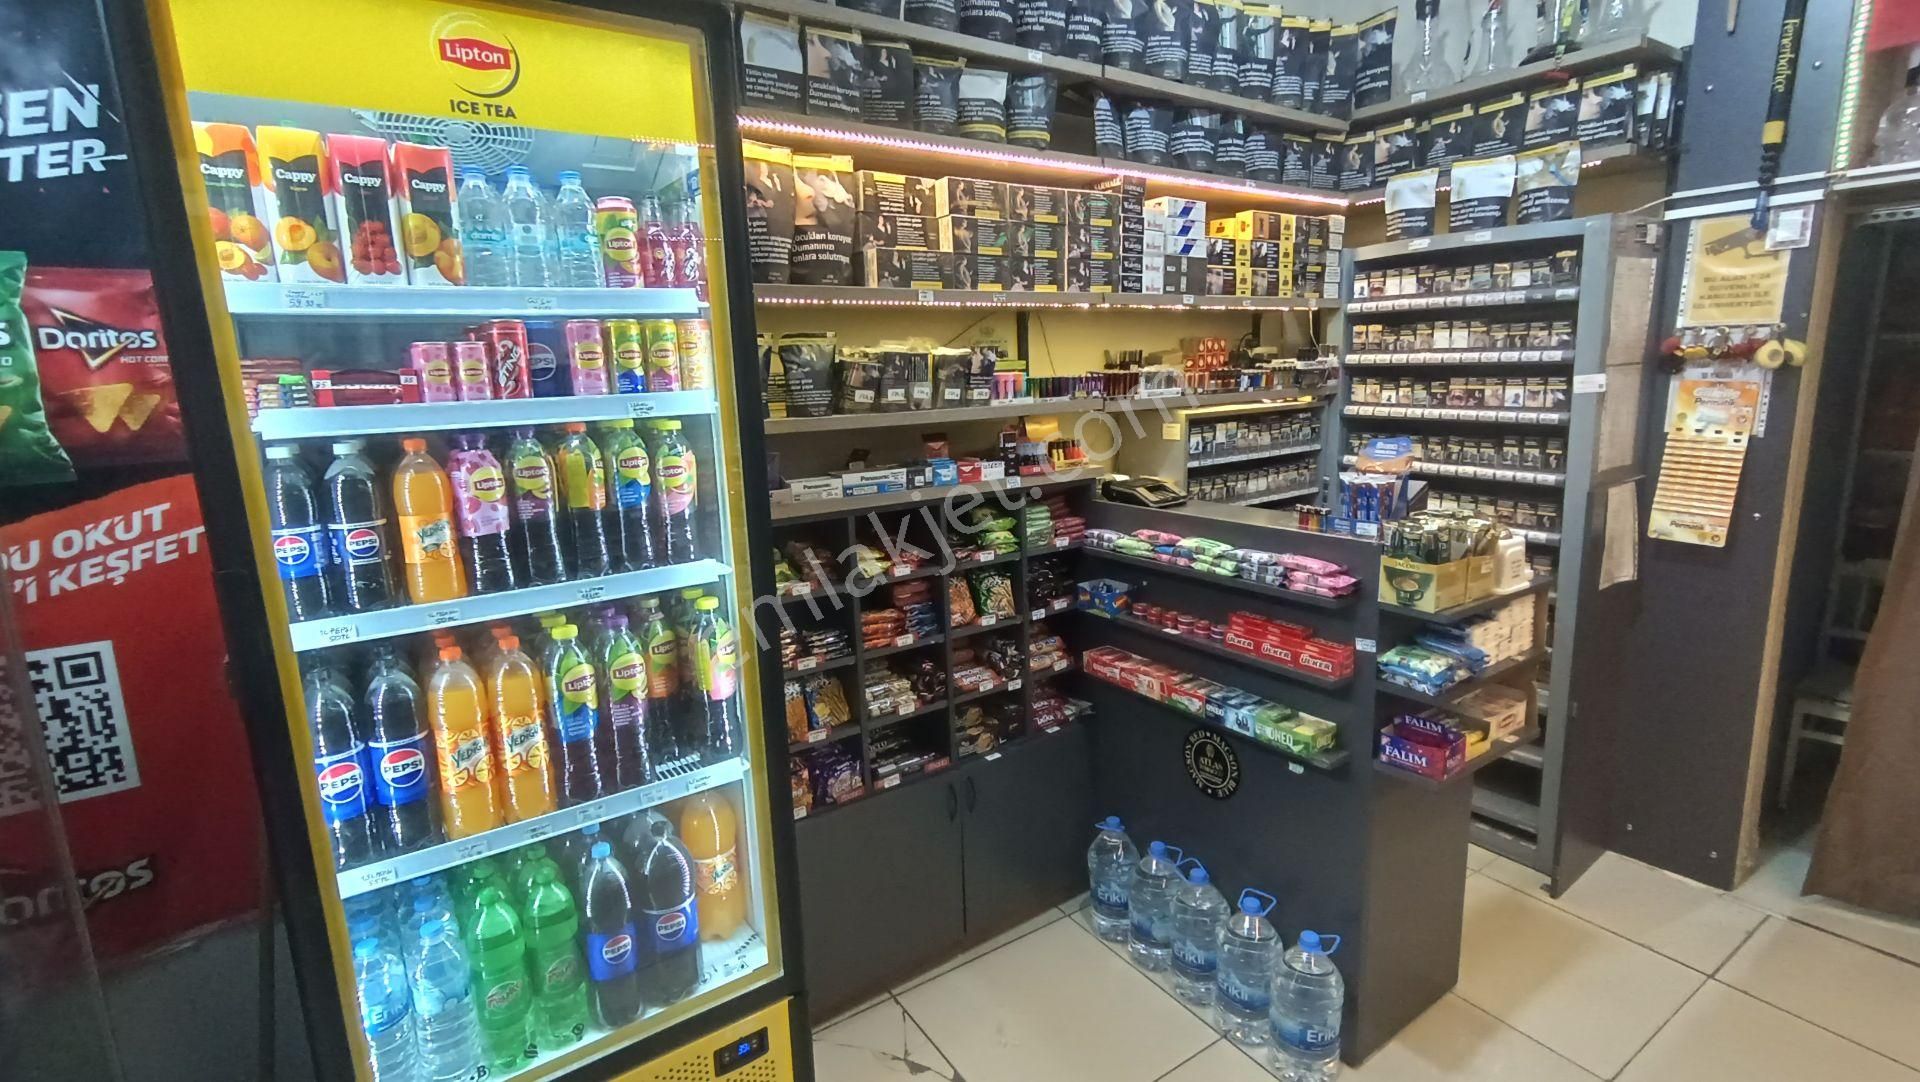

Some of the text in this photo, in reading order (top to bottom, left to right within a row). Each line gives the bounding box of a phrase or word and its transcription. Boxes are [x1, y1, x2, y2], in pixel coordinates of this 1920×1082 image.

[445, 42, 505, 65] Lipton
[450, 99, 518, 120] ICE TEA
[201, 163, 244, 179] Cappy
[275, 168, 317, 184] Cappy
[343, 172, 382, 188] Cappy
[411, 178, 446, 193] Cappy
[38, 327, 157, 351] Doritos
[52, 502, 172, 559] OKUT
[275, 545, 308, 556] PEPSI
[348, 537, 378, 548] PEPSI
[48, 525, 206, 597] KEŞFET
[1299, 652, 1333, 673] ÜLKER
[1404, 714, 1443, 733] FALIM
[1385, 744, 1428, 768] FALIM
[384, 759, 423, 775] PEPSI
[320, 774, 362, 791] PEPSI
[657, 919, 685, 932] PEPSI
[603, 942, 632, 957] PEPSI
